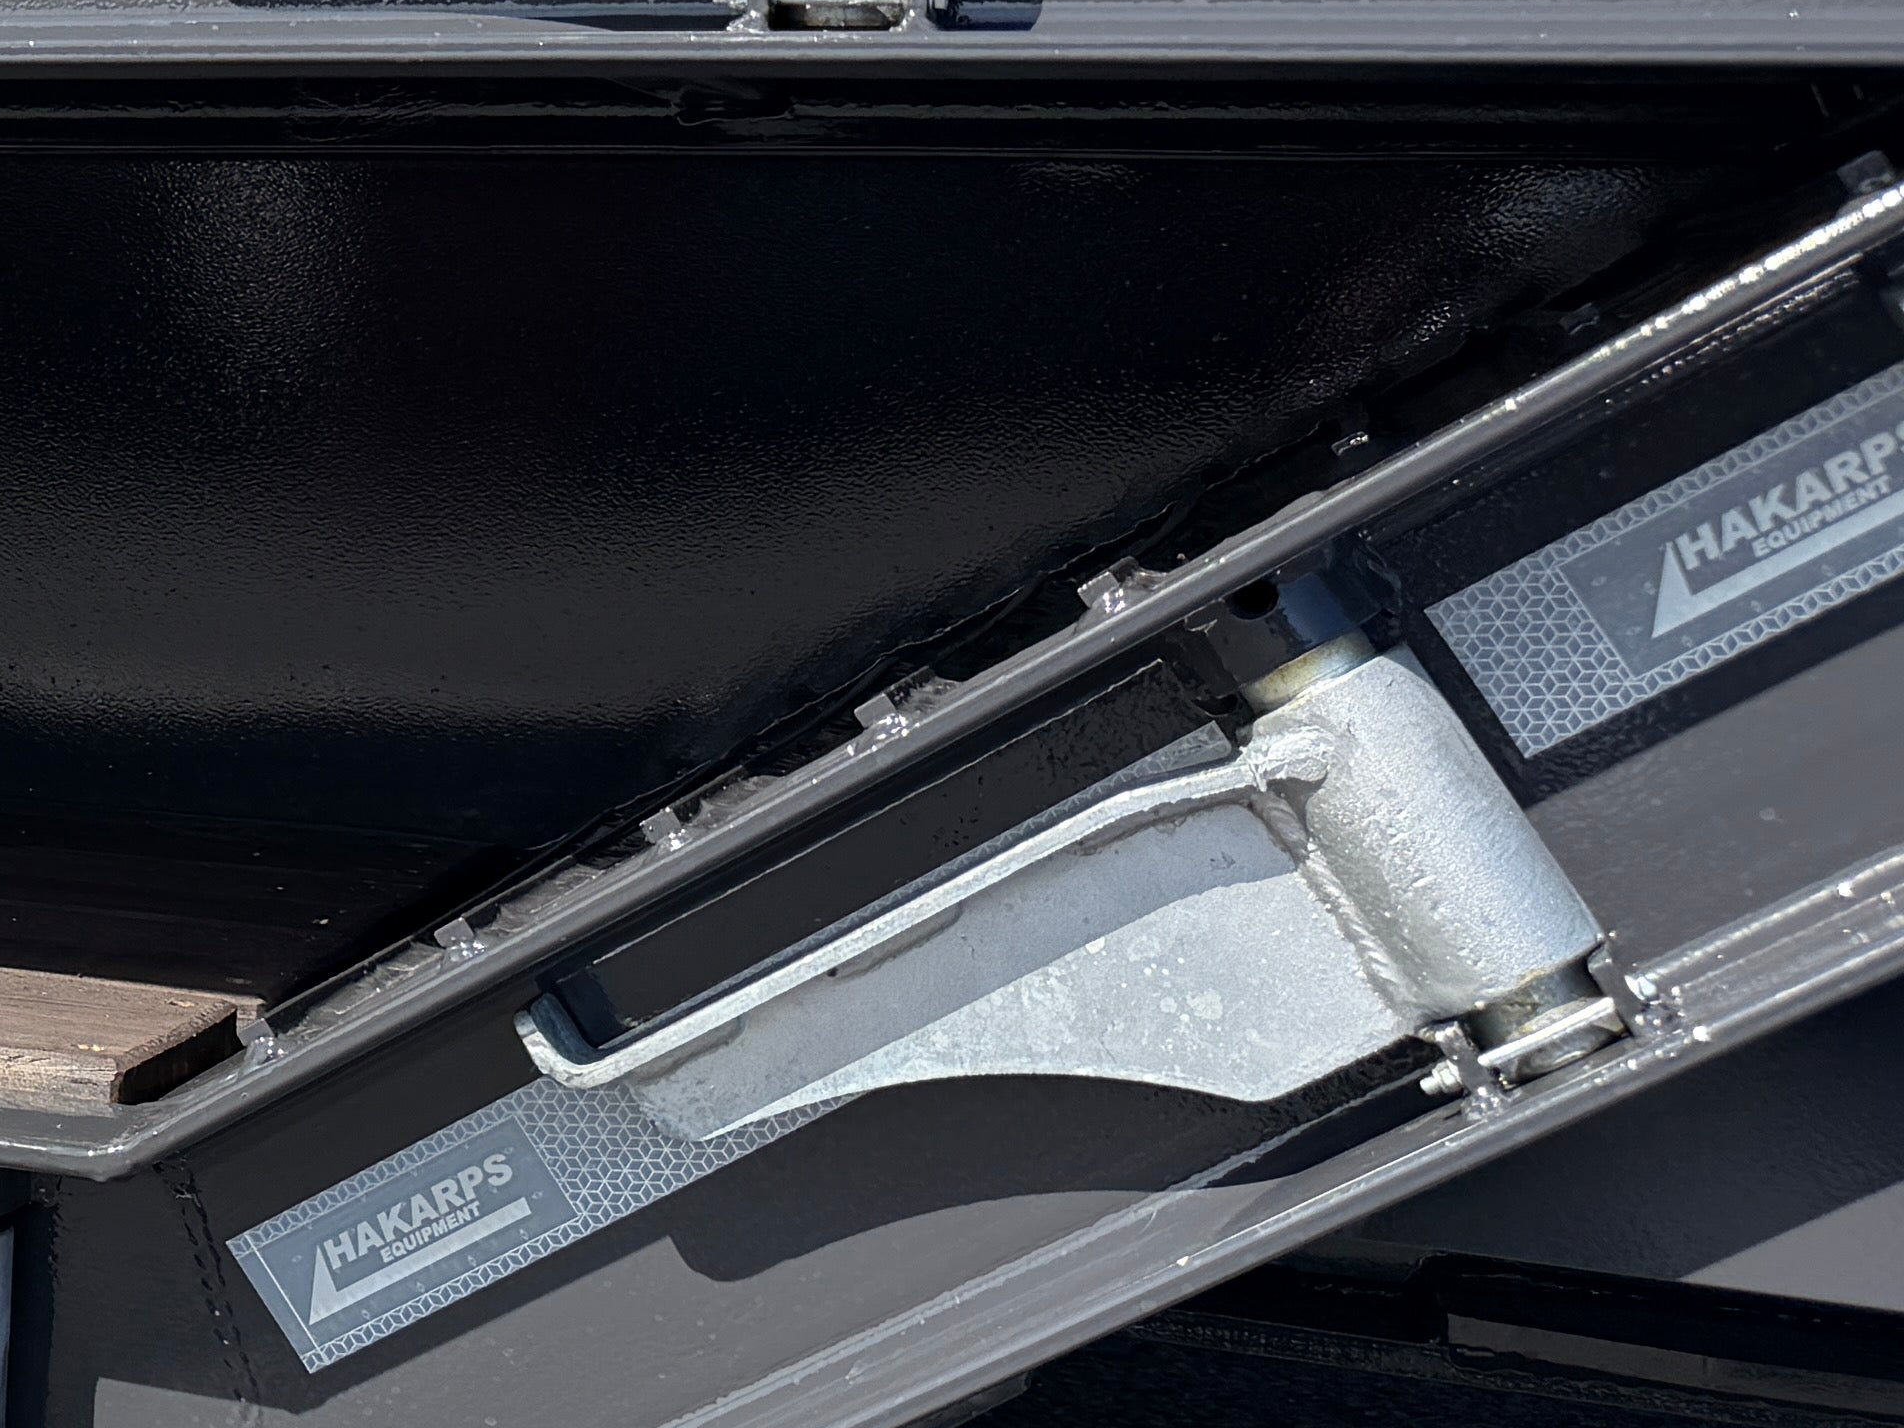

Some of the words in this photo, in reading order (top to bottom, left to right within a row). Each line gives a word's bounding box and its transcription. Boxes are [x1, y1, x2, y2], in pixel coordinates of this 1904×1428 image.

[1751, 474, 1892, 558] EQUIPMENT
[323, 1153, 513, 1270] HAKARPS
[379, 1201, 480, 1263] EQUIPMENT
